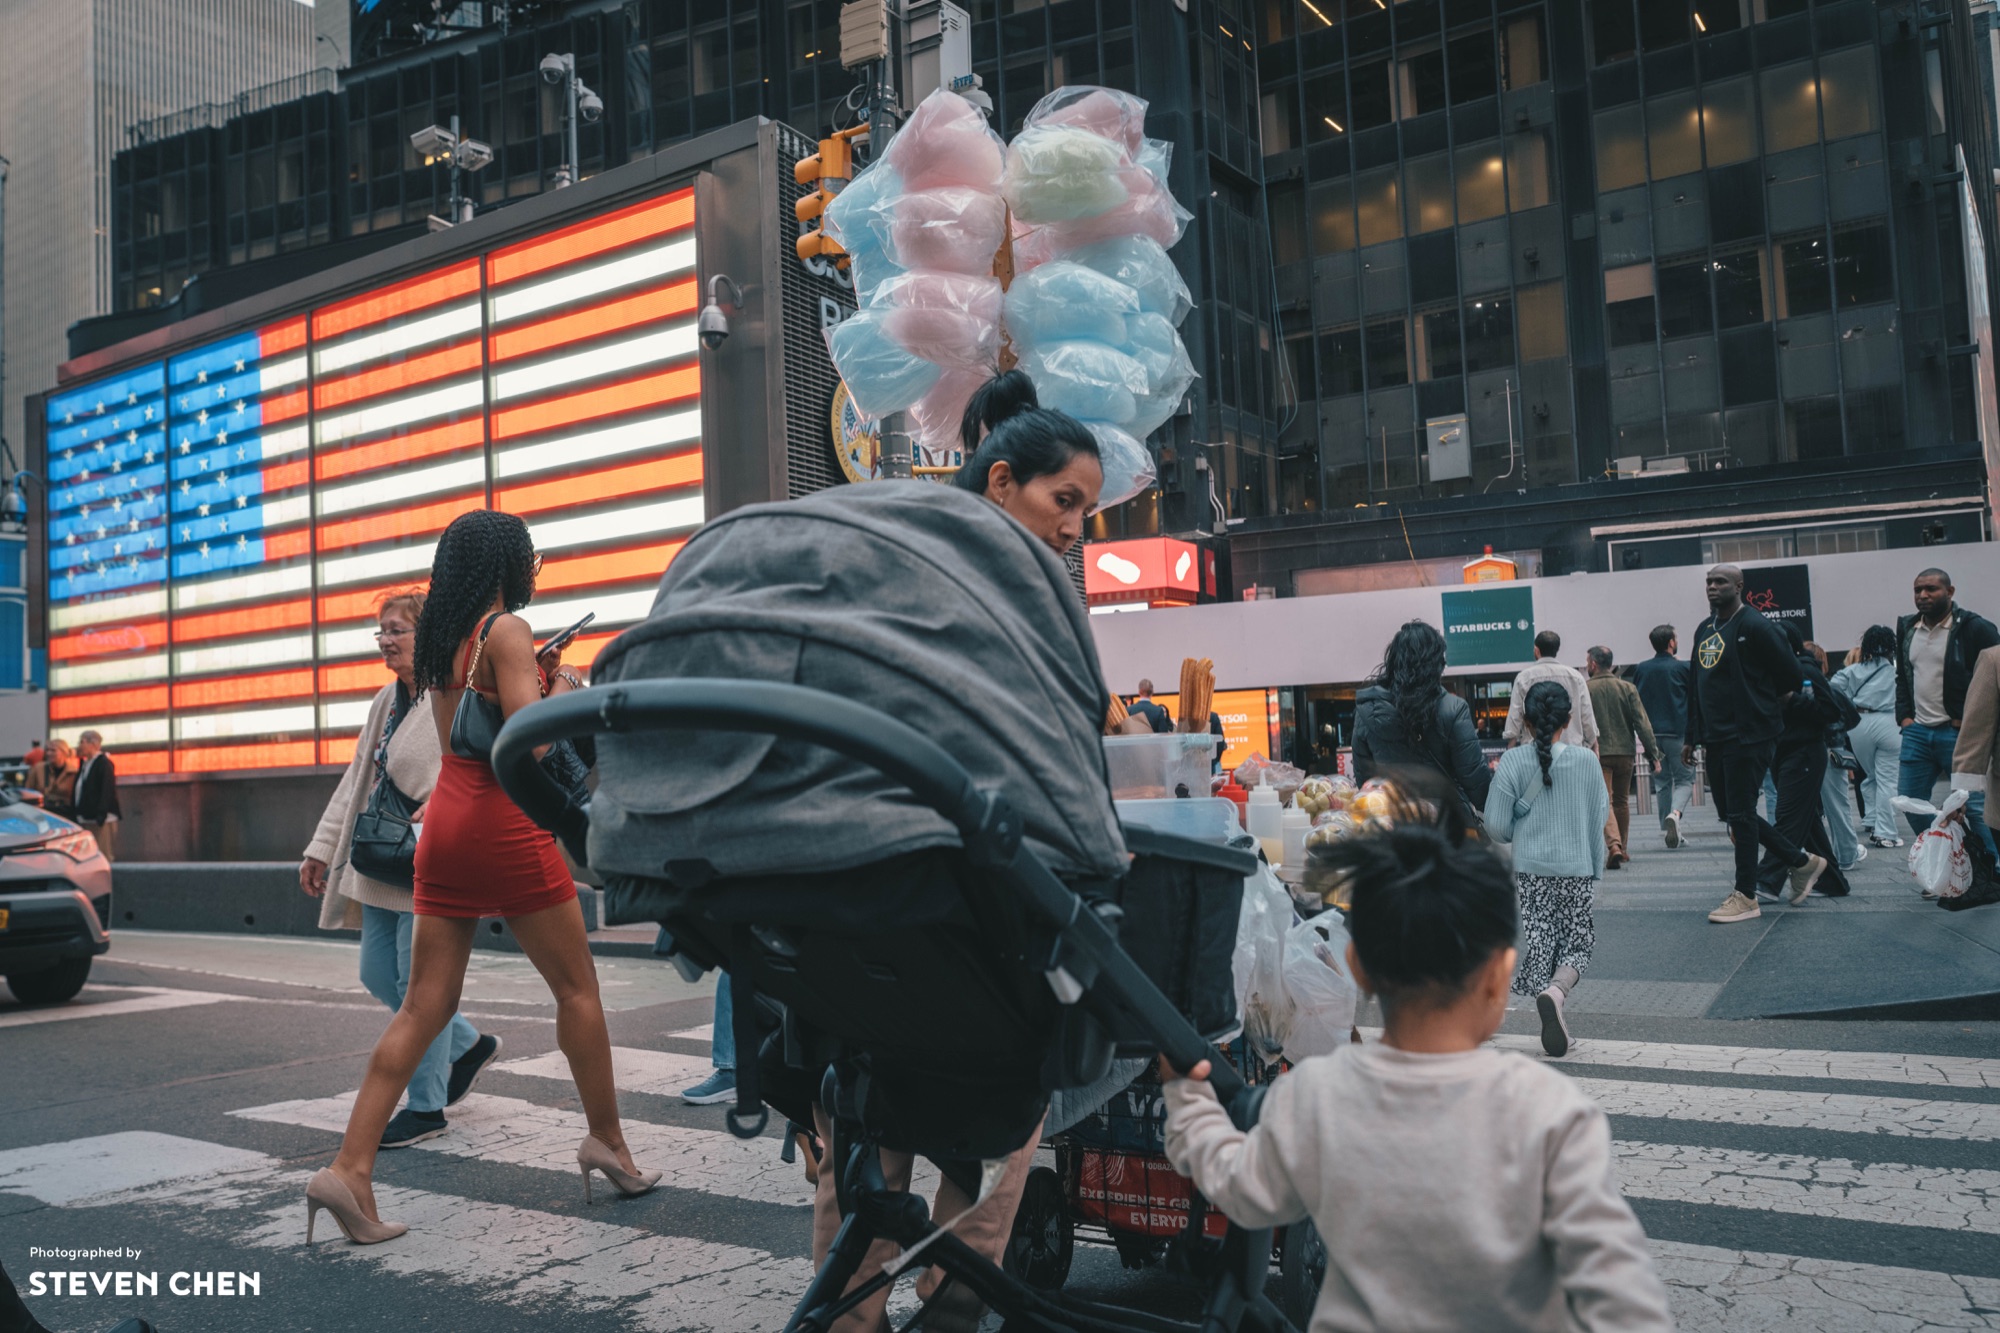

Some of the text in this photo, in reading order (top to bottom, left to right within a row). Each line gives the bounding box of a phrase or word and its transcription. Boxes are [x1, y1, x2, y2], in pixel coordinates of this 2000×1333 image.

[1449, 621, 1512, 633] STARBUCKS
[1219, 713, 1248, 724] erson
[1130, 1212, 1209, 1231] EVERYD!
